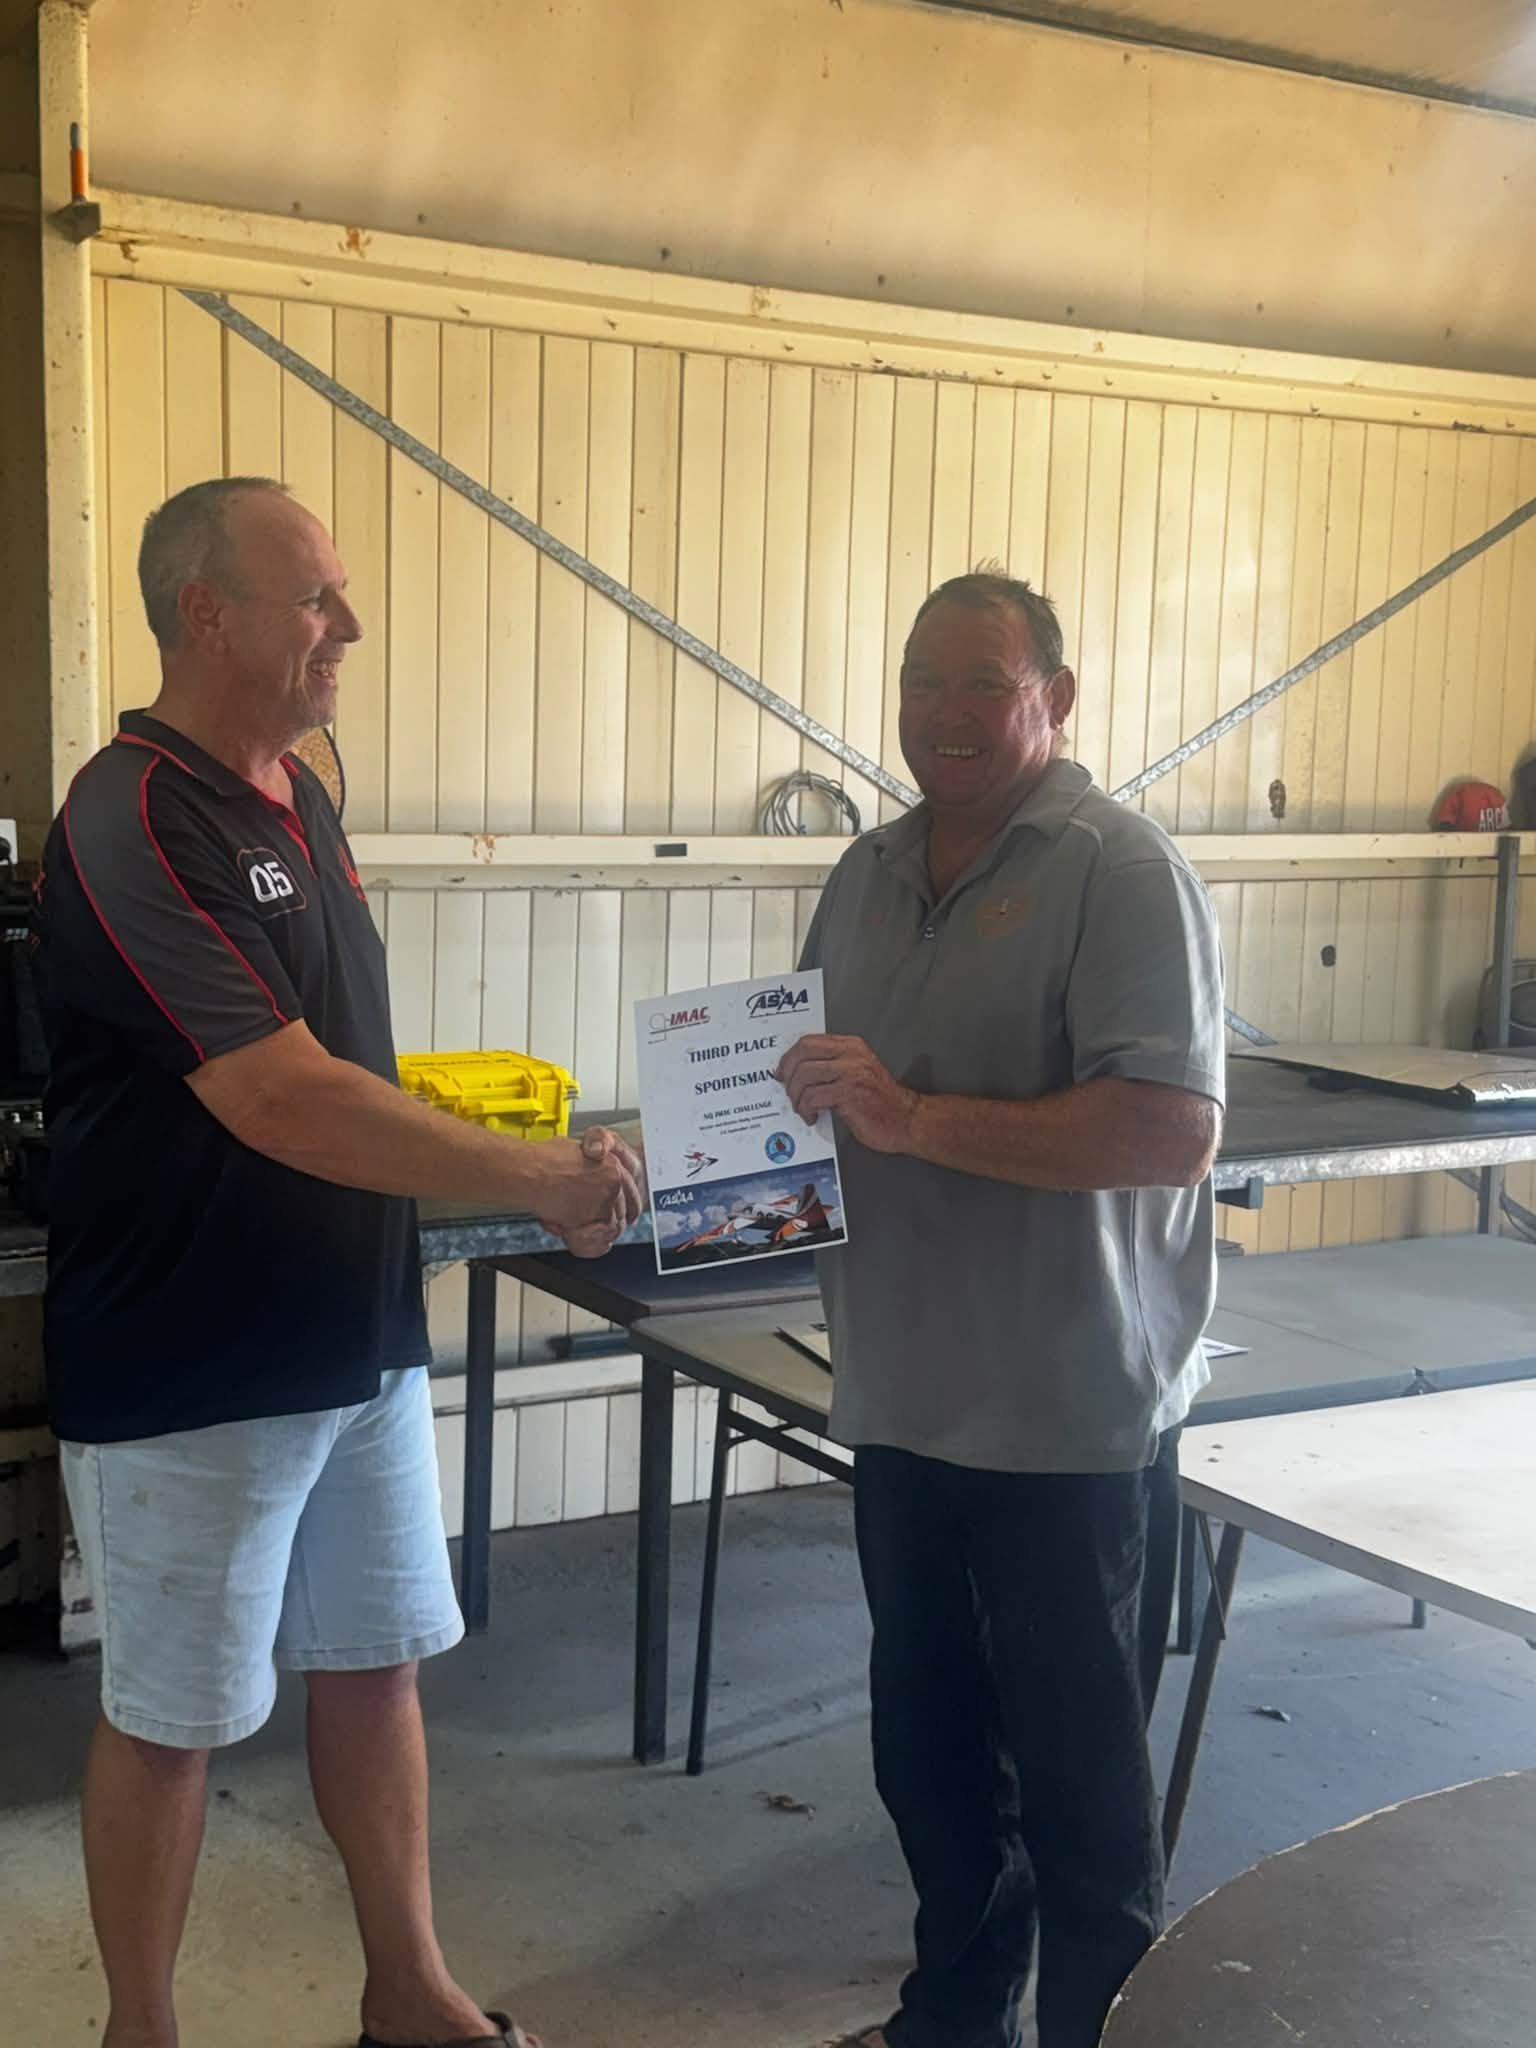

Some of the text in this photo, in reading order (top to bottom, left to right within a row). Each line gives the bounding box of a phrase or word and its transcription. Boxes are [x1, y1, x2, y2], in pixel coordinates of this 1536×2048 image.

[748, 987, 809, 1014] ASAA
[671, 1006, 709, 1026] IMAC
[689, 1035, 777, 1063] THIRD PLACE
[694, 1069, 776, 1095] SPORTSMAN
[733, 1100, 772, 1114] CHALLENGE
